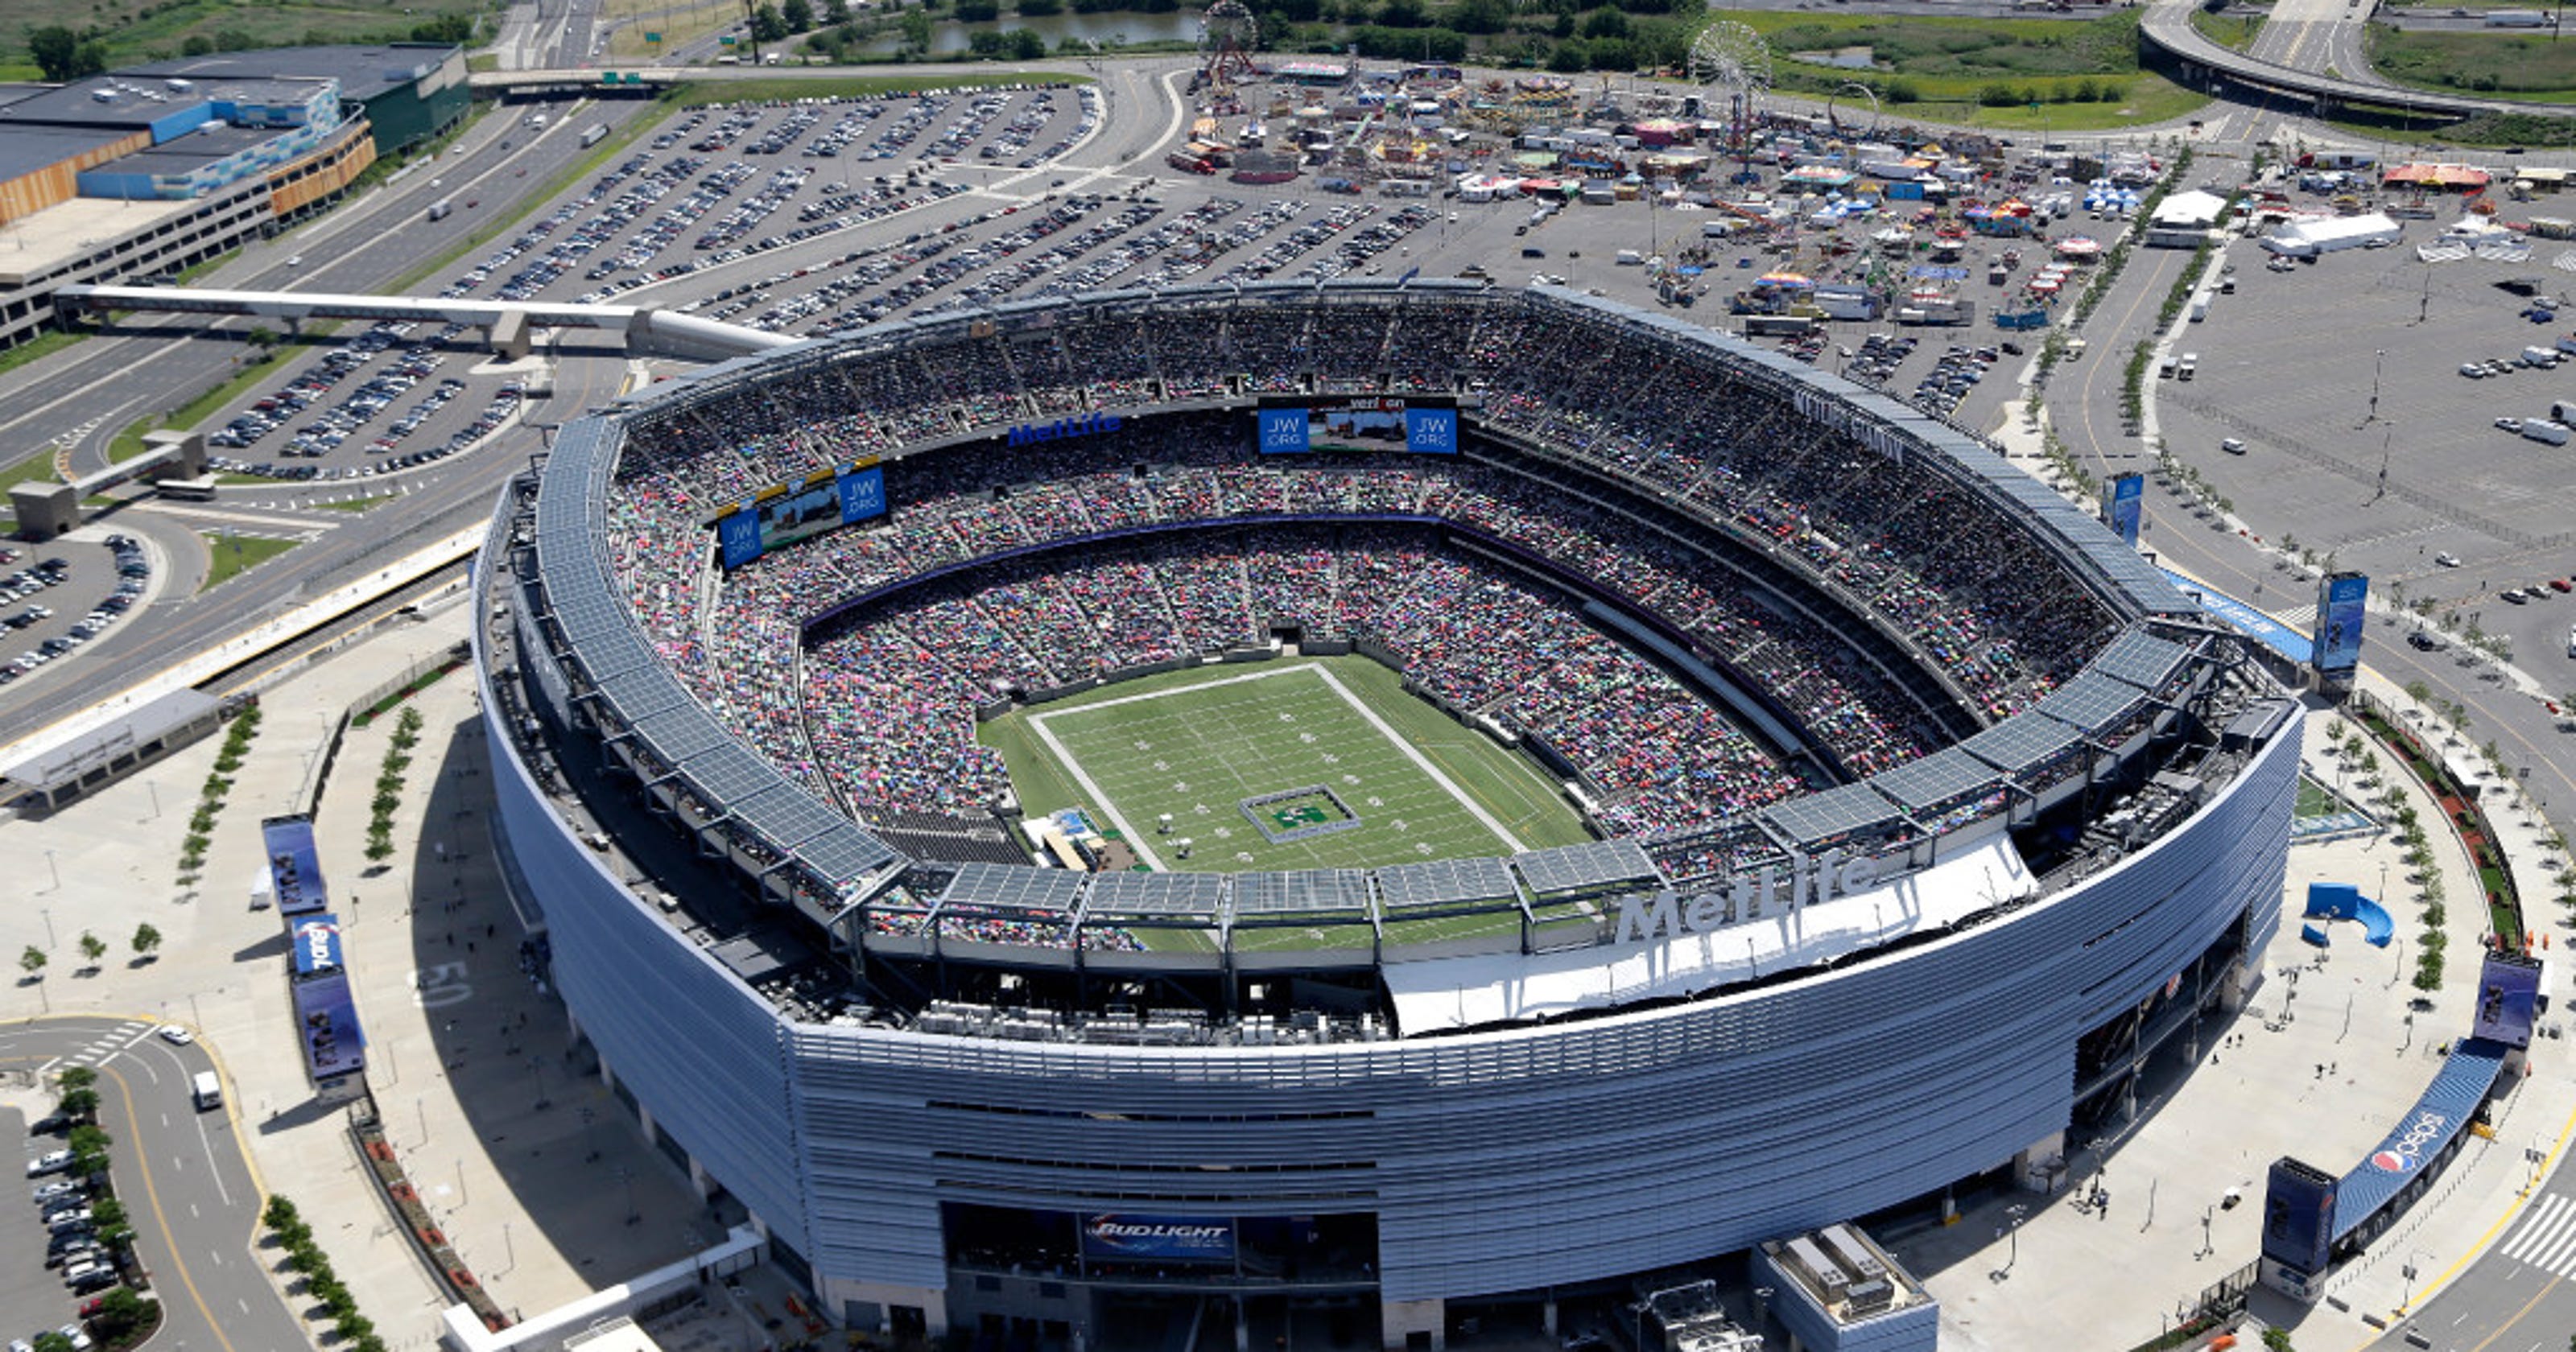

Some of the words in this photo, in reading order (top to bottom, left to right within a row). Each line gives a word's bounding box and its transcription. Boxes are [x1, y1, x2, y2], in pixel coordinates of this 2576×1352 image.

[1350, 397, 1405, 409] verizon
[1008, 410, 1122, 447] MetLife
[1267, 417, 1299, 433] JW
[1417, 417, 1447, 433] JW
[848, 478, 877, 501] JW
[729, 520, 753, 545] JW
[1613, 847, 1879, 946] MetLife
[2396, 1111, 2446, 1156] pepsi
[1096, 1222, 1152, 1236] BUD
[1153, 1224, 1228, 1238] LIGHT
